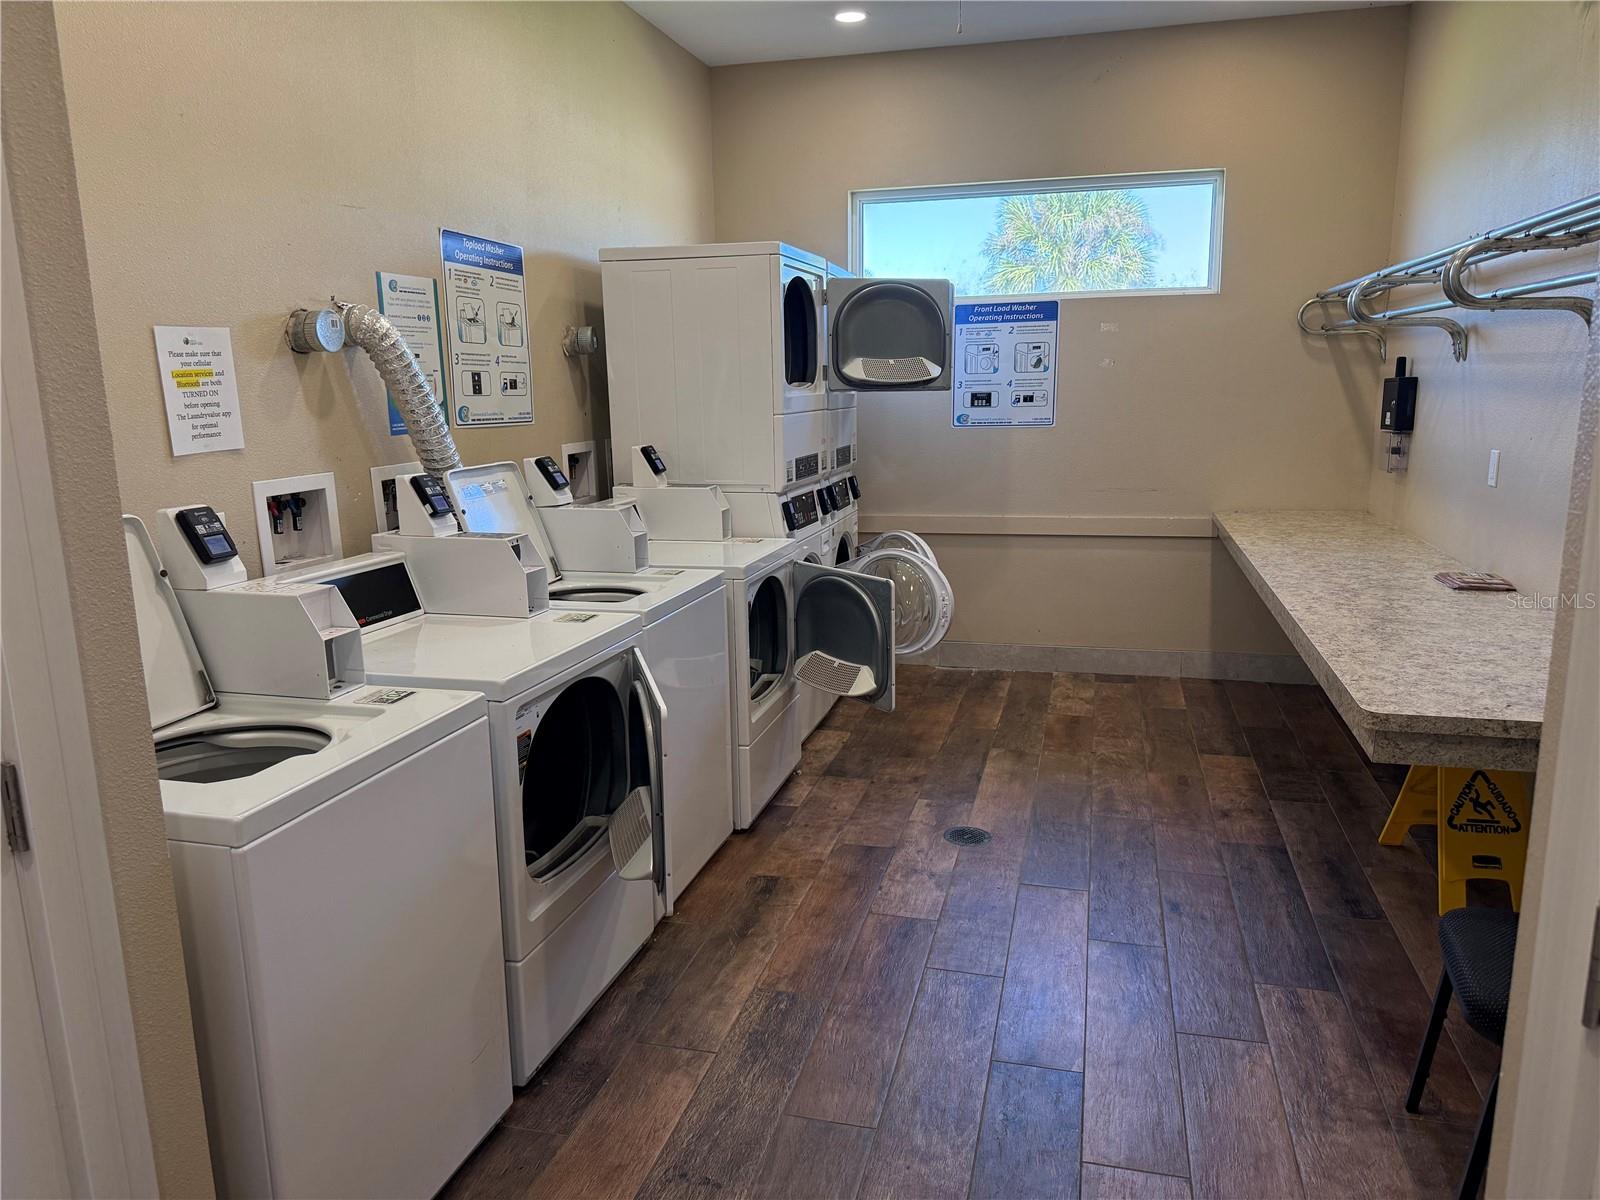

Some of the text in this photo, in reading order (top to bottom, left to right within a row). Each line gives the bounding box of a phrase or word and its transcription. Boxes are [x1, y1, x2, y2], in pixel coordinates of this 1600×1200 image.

[462, 238, 505, 256] Topload Washer
[454, 249, 514, 270] Operating Instructions
[489, 275, 495, 287] 2
[974, 303, 1038, 313] Front Load Washer
[968, 312, 1044, 323] Operating Instructions
[1008, 326, 1015, 335] 2
[168, 350, 184, 358] Please
[454, 353, 460, 365] 3
[192, 359, 212, 367] cellular
[495, 355, 500, 367] 4
[171, 369, 224, 378] Location services and
[176, 379, 200, 388] Bluetooth
[957, 381, 963, 389] 3
[1006, 380, 1013, 388] 4
[182, 389, 219, 398] TURNED ON
[200, 401, 220, 410] opening
[176, 413, 186, 421] The
[222, 411, 232, 419] app
[199, 421, 219, 430] optimal
[191, 431, 222, 441] performance
[1450, 780, 1476, 816] CAUTION
[1487, 782, 1517, 820] CUIDADO
[1458, 823, 1511, 835] ATTENTION
